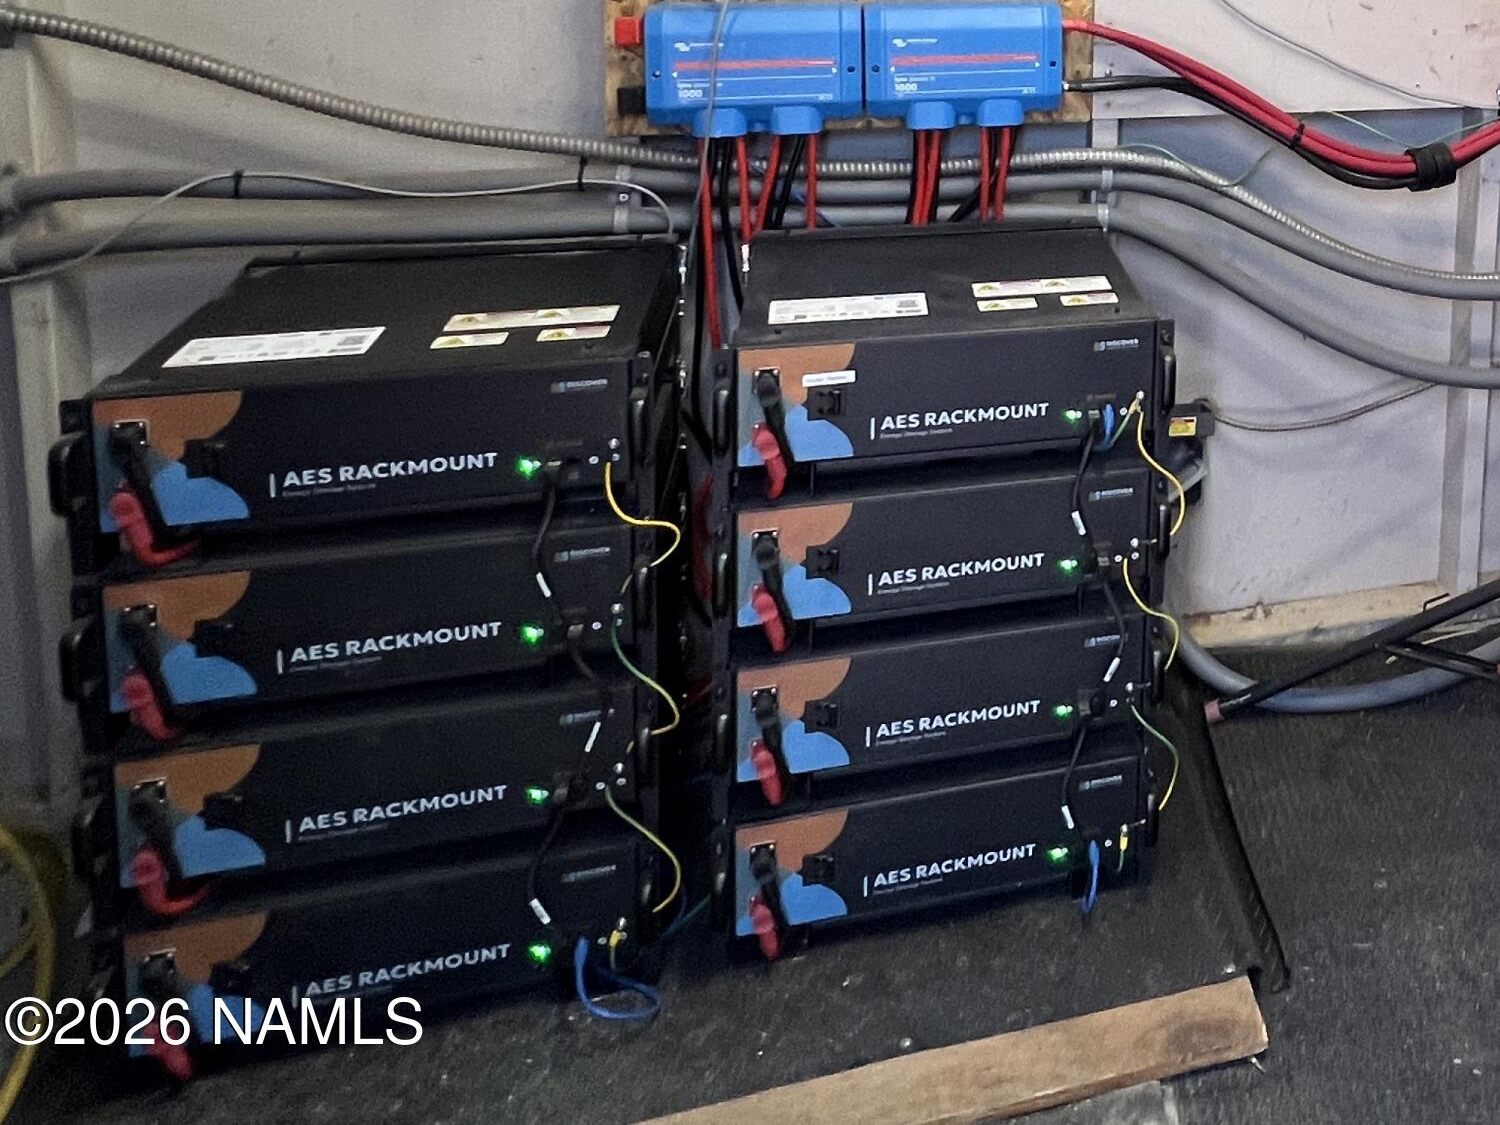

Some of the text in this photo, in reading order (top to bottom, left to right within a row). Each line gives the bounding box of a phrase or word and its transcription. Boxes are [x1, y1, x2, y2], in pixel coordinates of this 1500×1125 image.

[880, 403, 1049, 430] AES RACKMOUNT
[282, 452, 498, 488] AES RACKMOUNT
[878, 553, 1045, 586] AES RACKMOUNT
[290, 622, 502, 663] AES RACKMOUNT
[876, 699, 1041, 738] AES RACKMOUNT
[299, 811, 347, 832] AES
[353, 785, 508, 823] RACKMOUNT
[873, 868, 911, 888] AES
[916, 843, 1036, 879] RACKMOUNT
[305, 943, 511, 996] AES RACKMOUNT
